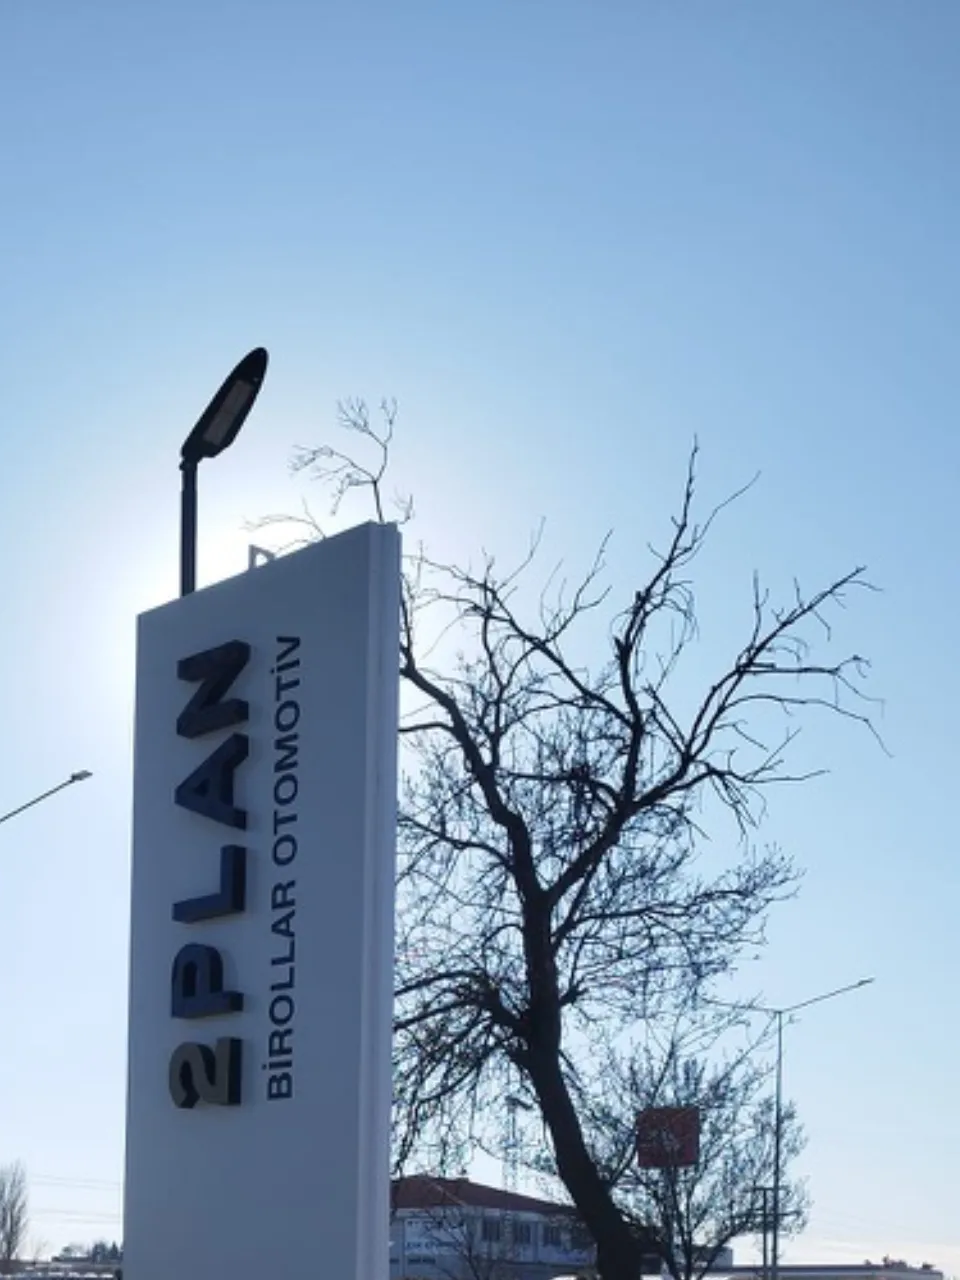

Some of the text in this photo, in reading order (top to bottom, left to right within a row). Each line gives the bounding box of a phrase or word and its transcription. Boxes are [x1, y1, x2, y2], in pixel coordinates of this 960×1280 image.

[169, 638, 251, 1110] 2PLAN
[261, 635, 301, 1102] BİROLLAR OTOMOTİV
